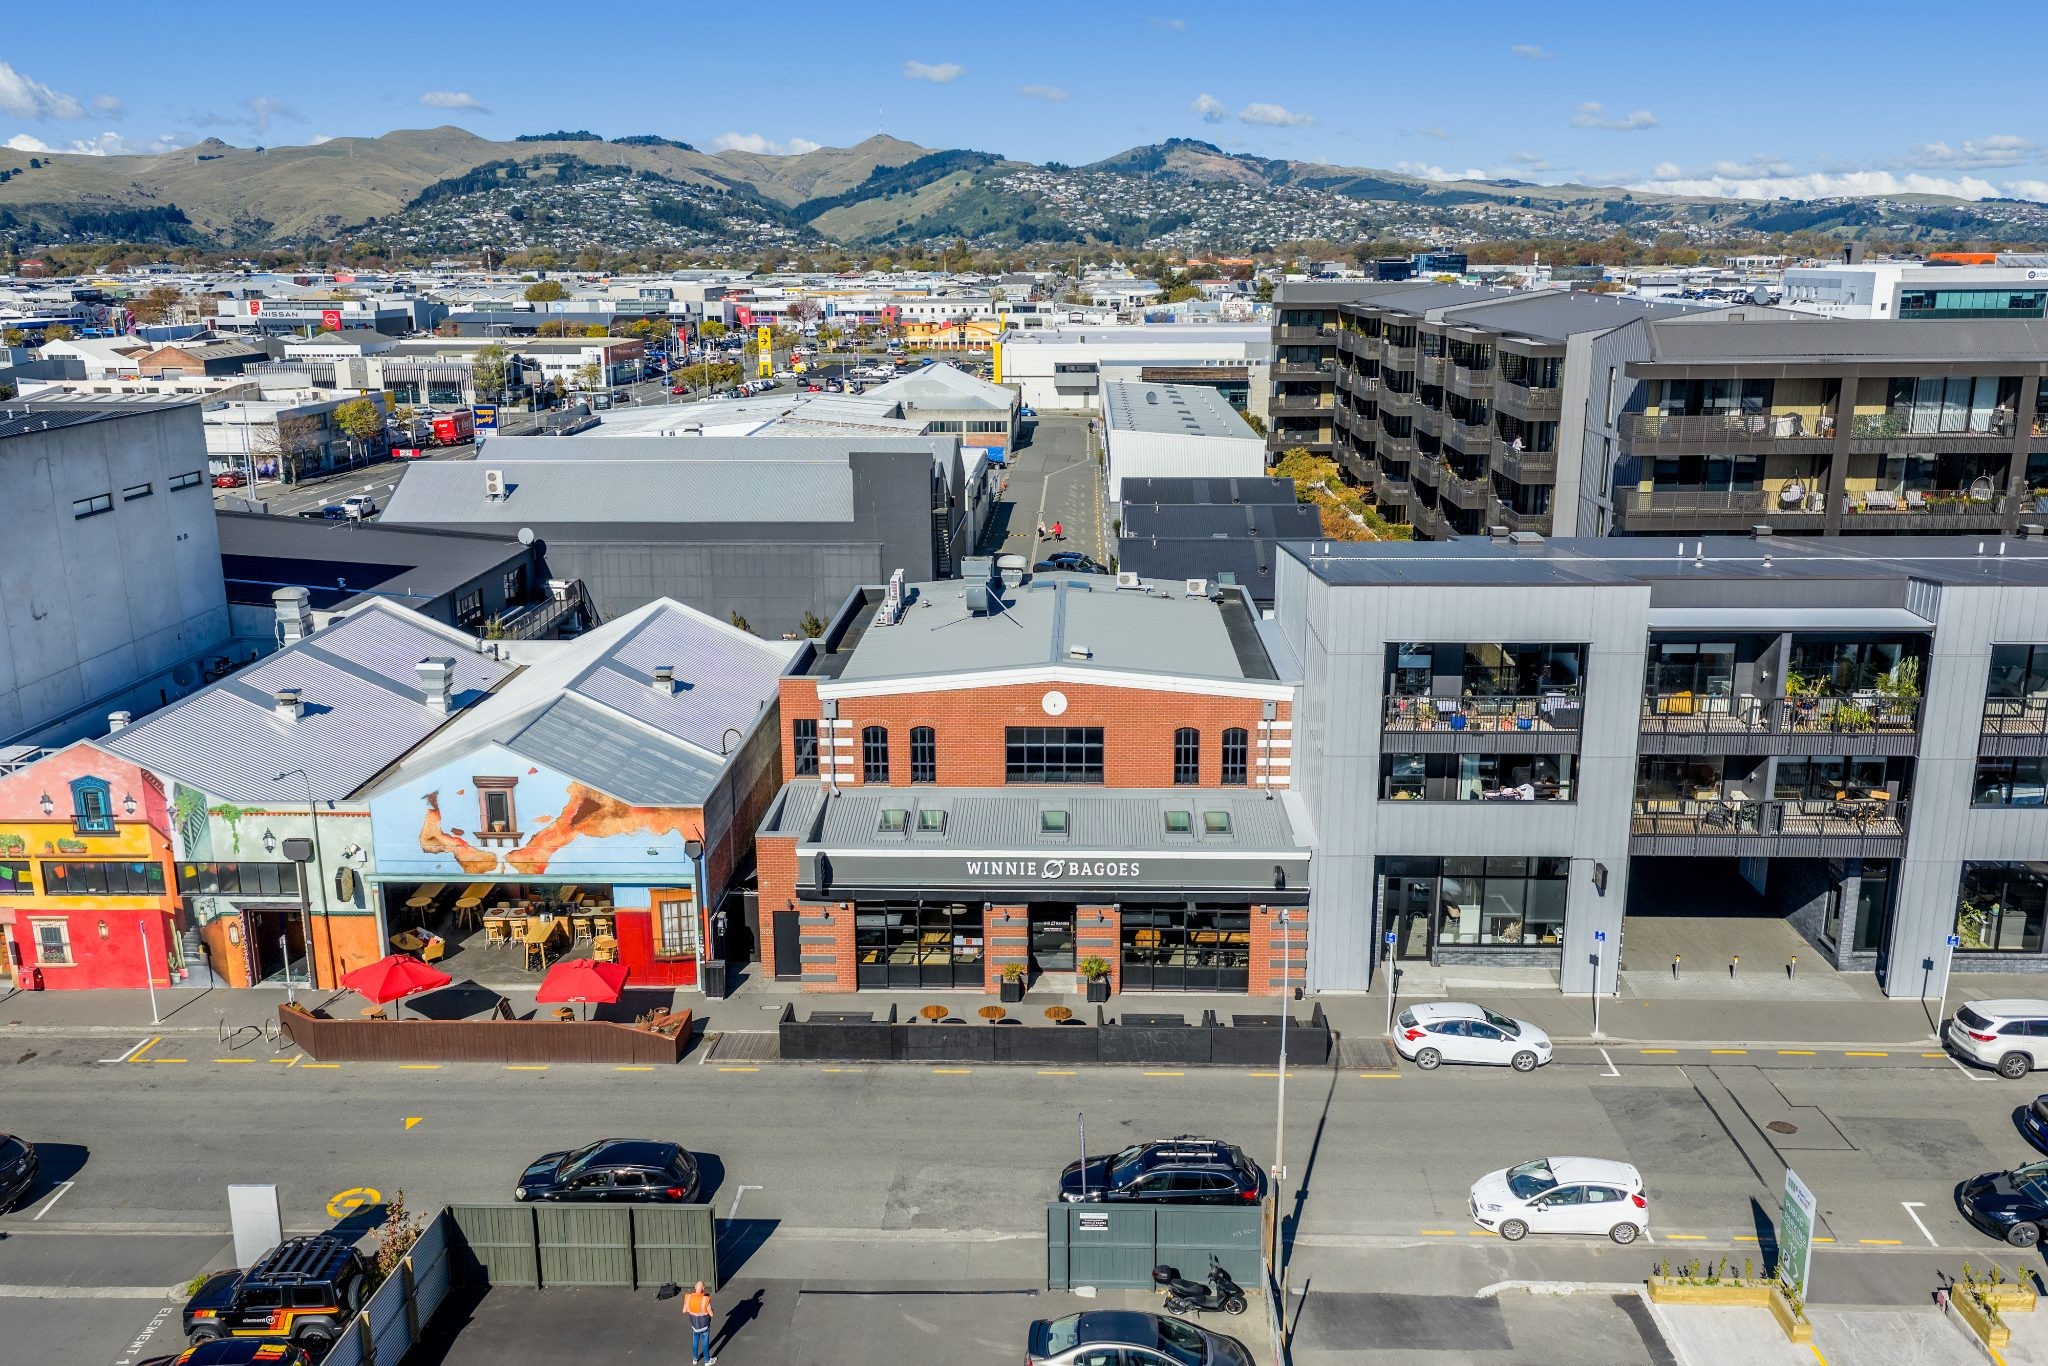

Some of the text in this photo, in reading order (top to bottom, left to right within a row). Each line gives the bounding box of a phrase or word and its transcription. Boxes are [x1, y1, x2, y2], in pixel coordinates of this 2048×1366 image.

[966, 861, 1141, 877] WINNIE BAGOES
[1784, 1211, 1807, 1244] PARKING
[1785, 1199, 1804, 1228] PUBLIC
[126, 1307, 174, 1355] ELEMENT
